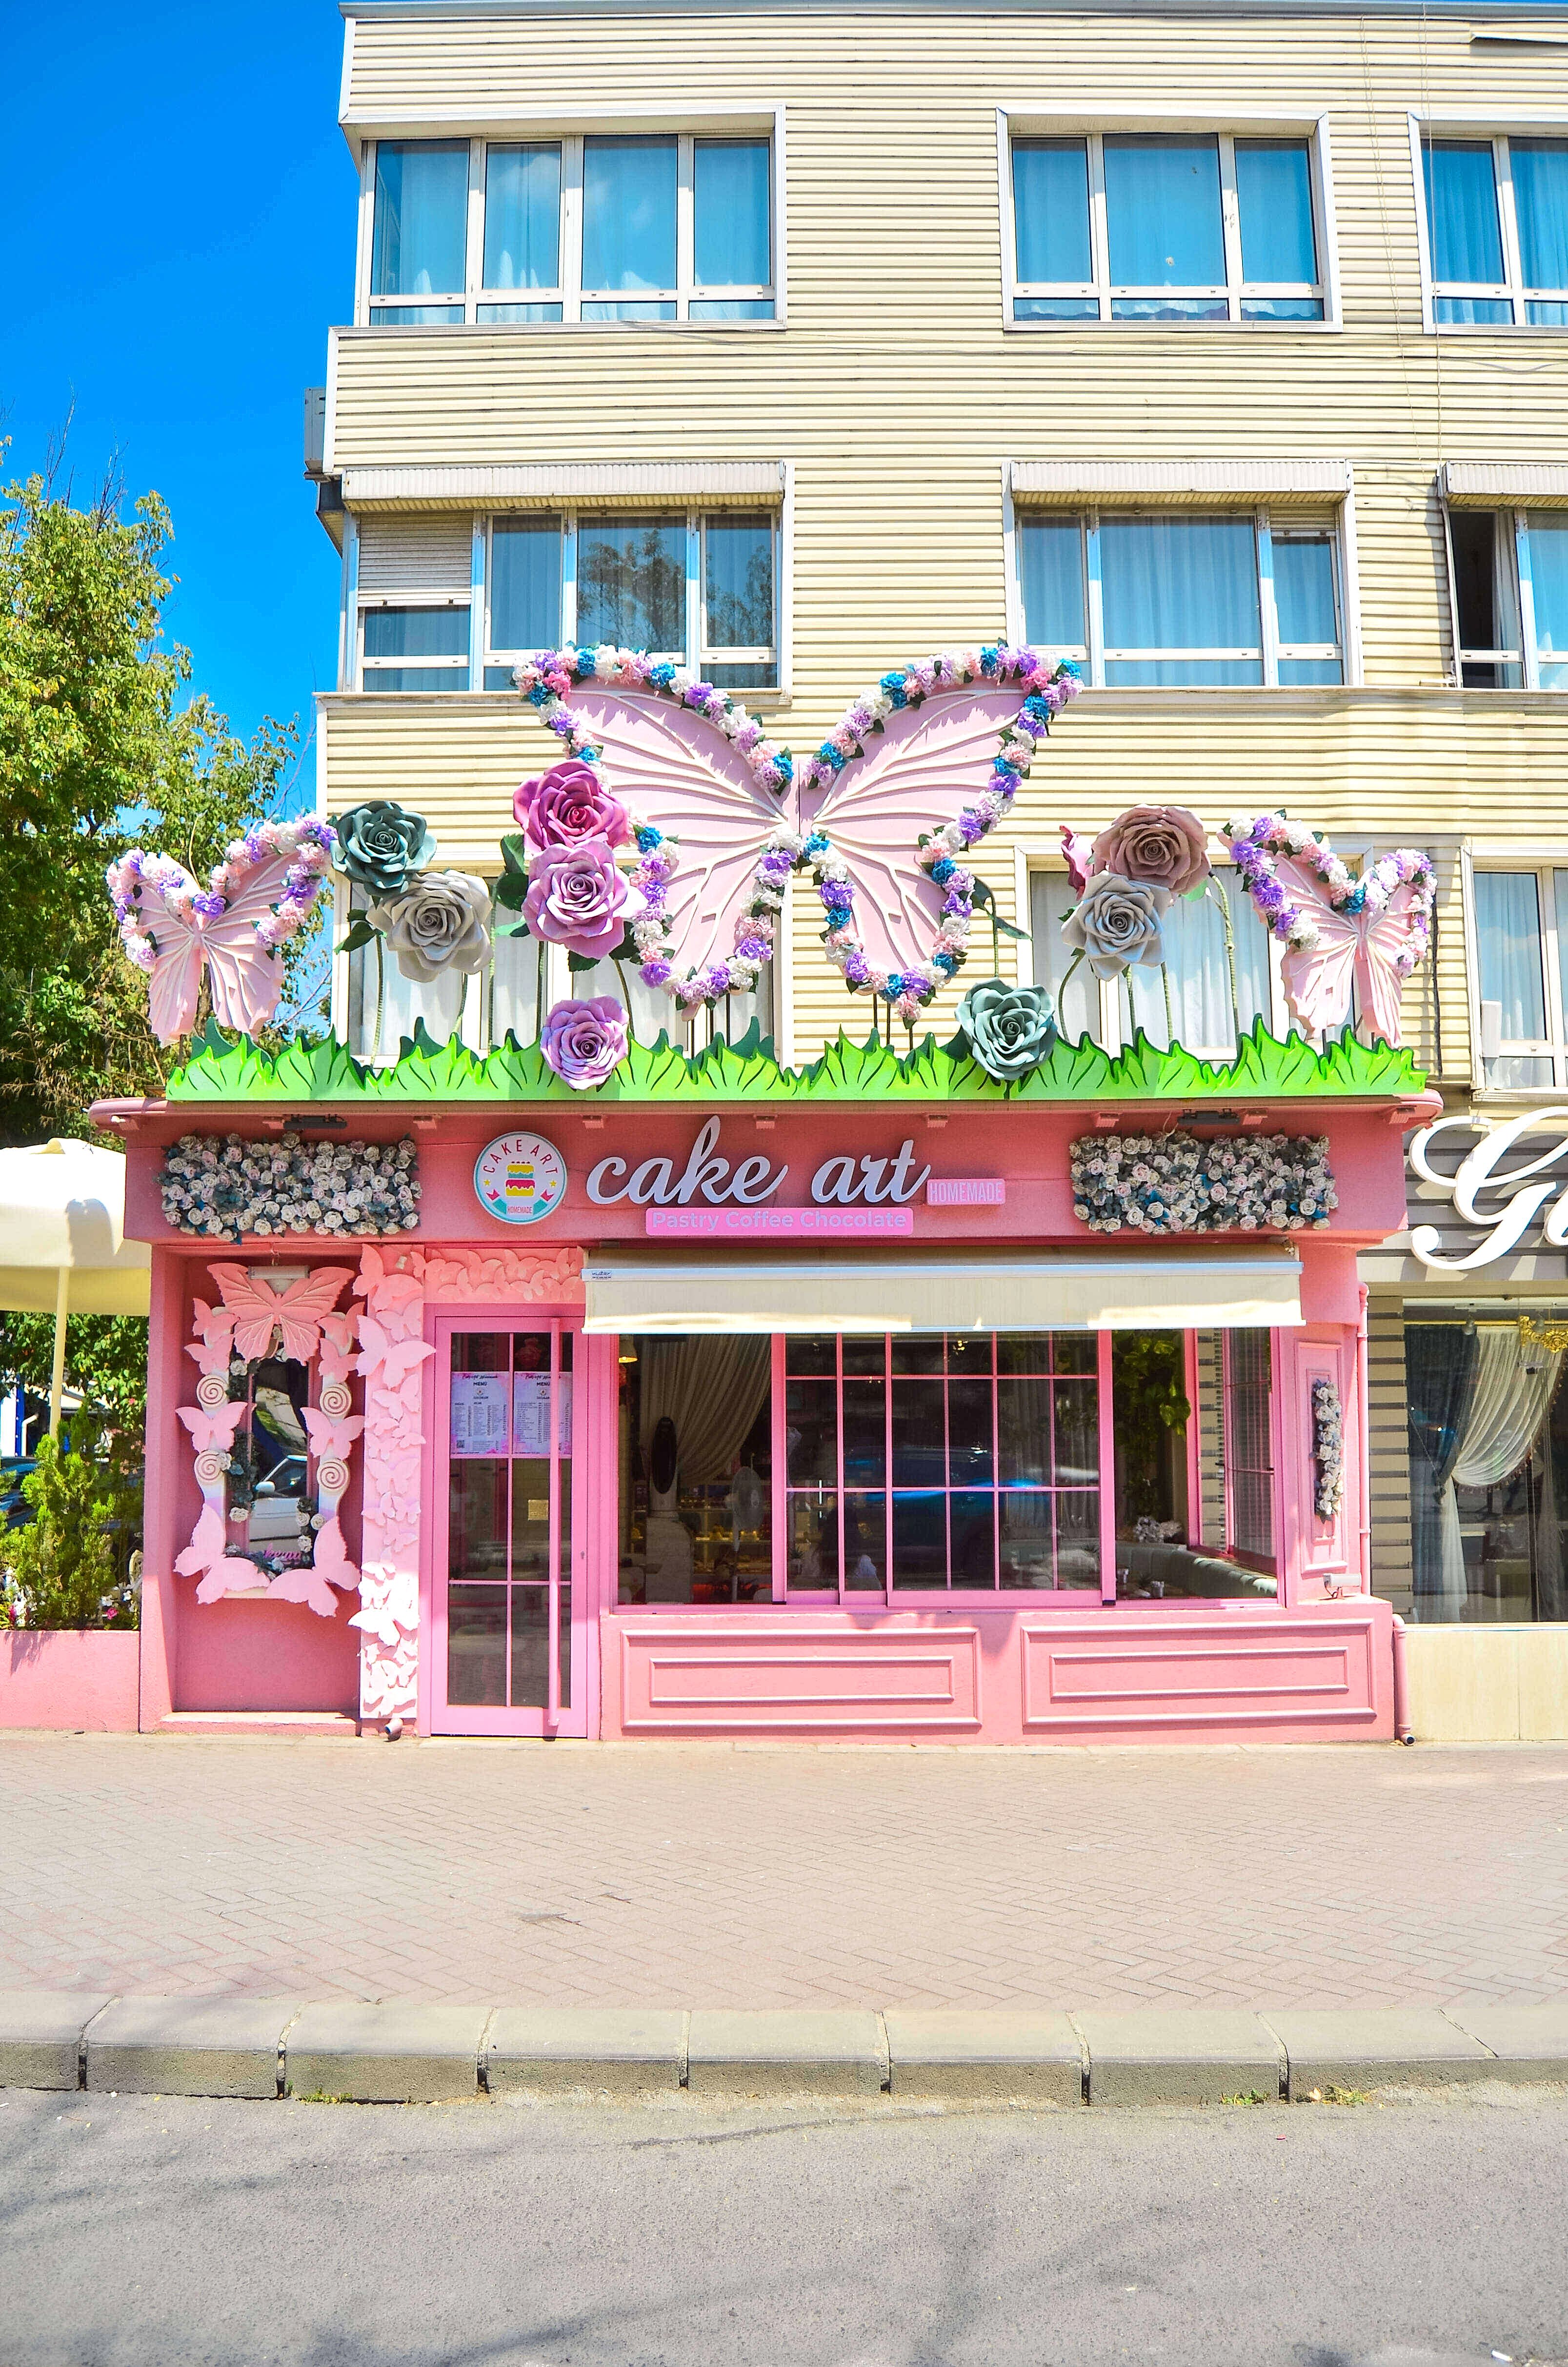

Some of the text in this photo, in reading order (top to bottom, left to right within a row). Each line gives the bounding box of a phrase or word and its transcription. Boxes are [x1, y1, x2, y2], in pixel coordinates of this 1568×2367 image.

[483, 1139, 558, 1173] CAKE ART
[586, 1115, 931, 1204] cake art
[928, 1182, 1003, 1203] HOMEMADE
[1409, 1106, 1568, 1270] G
[652, 1211, 905, 1232] Pastry Coffee Chocolate
